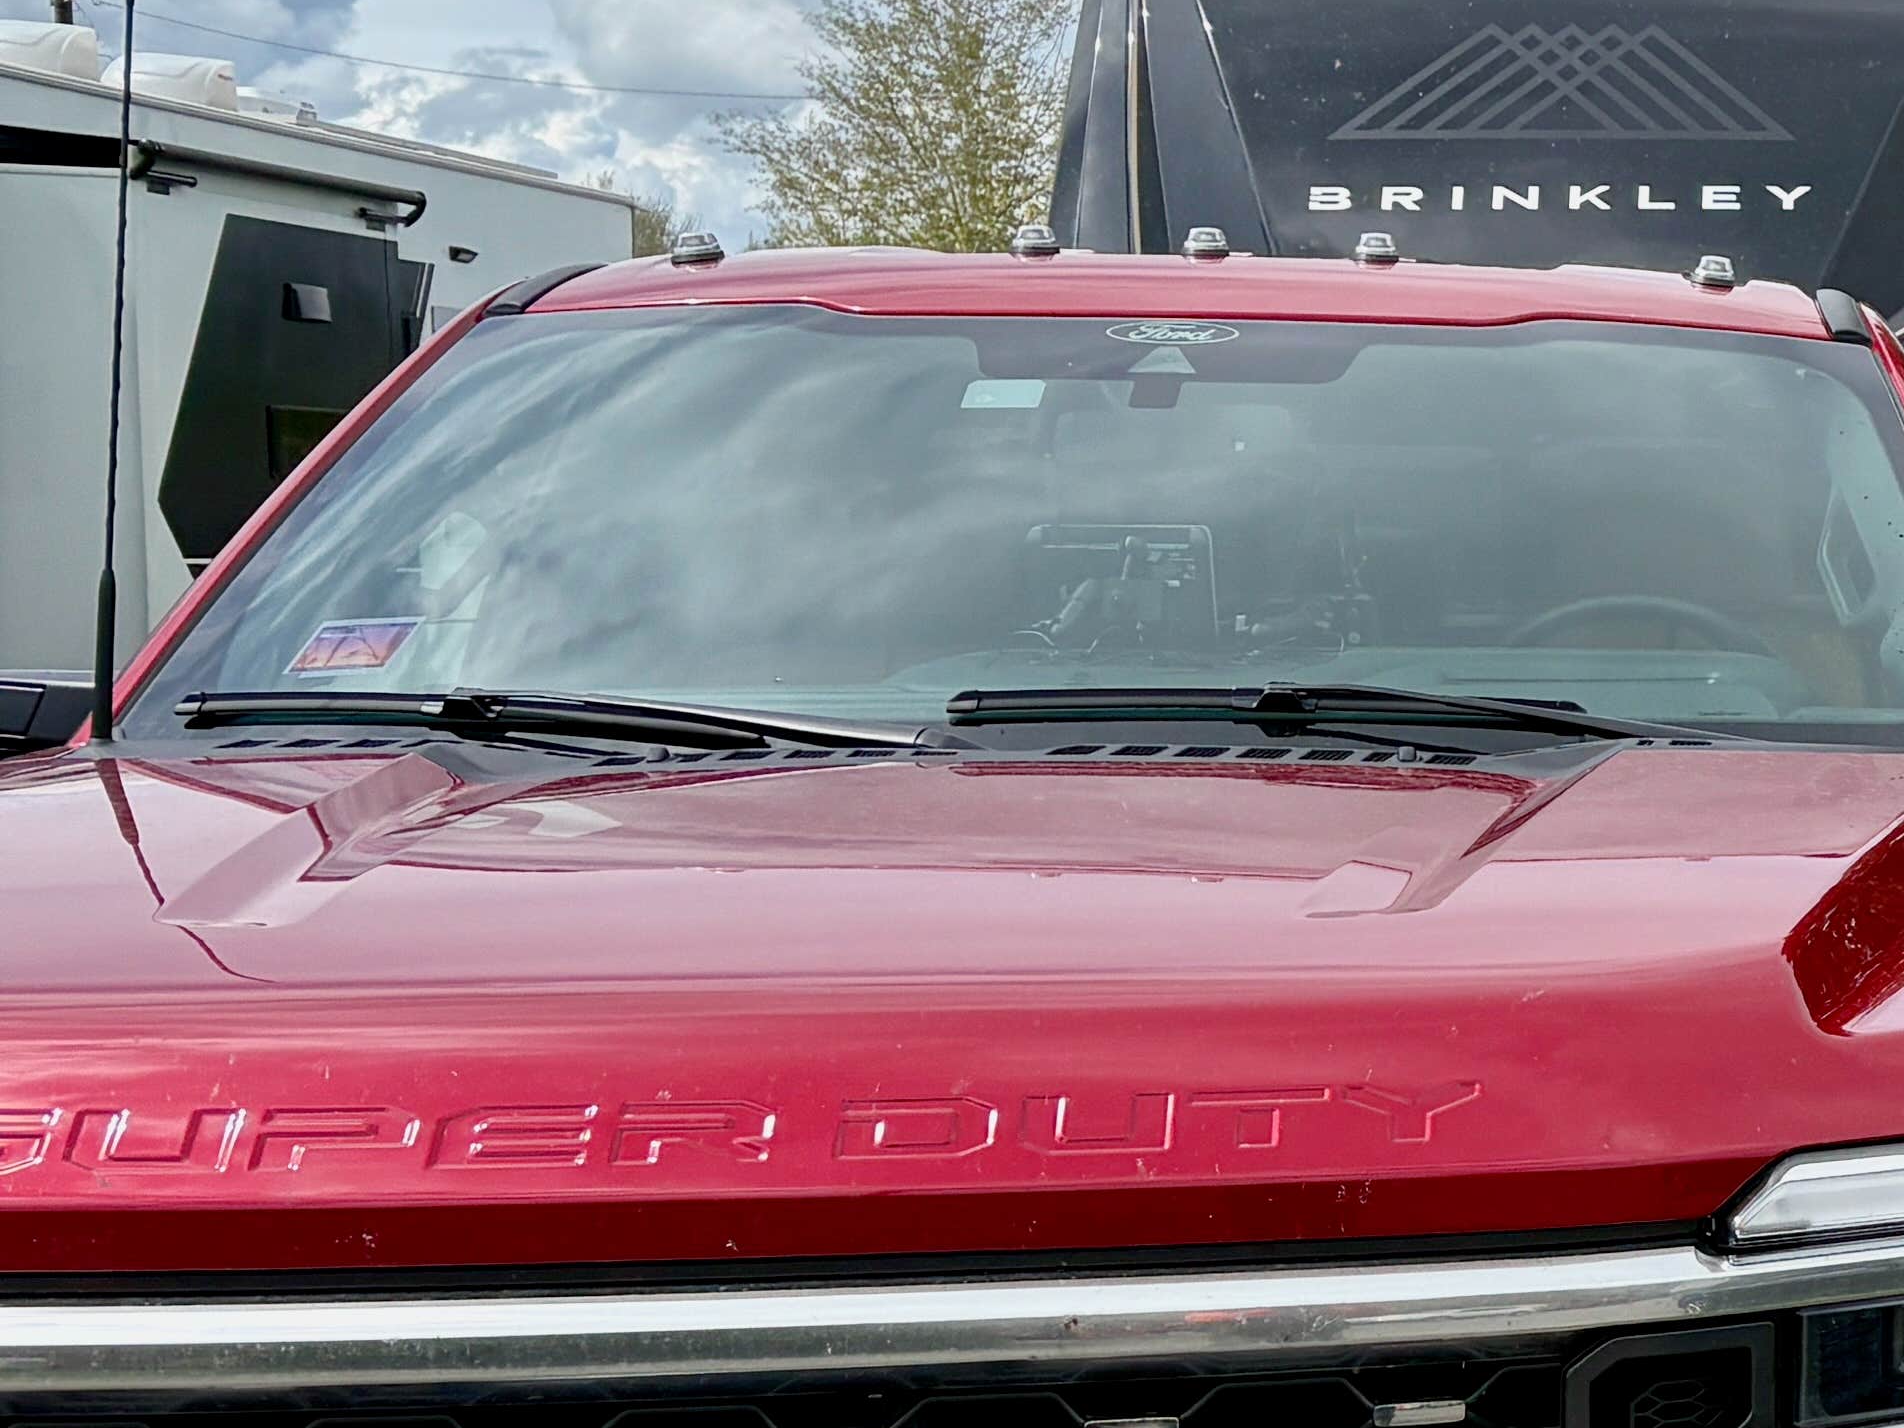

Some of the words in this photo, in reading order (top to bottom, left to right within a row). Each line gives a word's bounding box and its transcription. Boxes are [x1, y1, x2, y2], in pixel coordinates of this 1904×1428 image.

[1307, 184, 1813, 211] BRINKLEY
[1128, 323, 1217, 341] Ford
[832, 1081, 1483, 1160] DUTY
